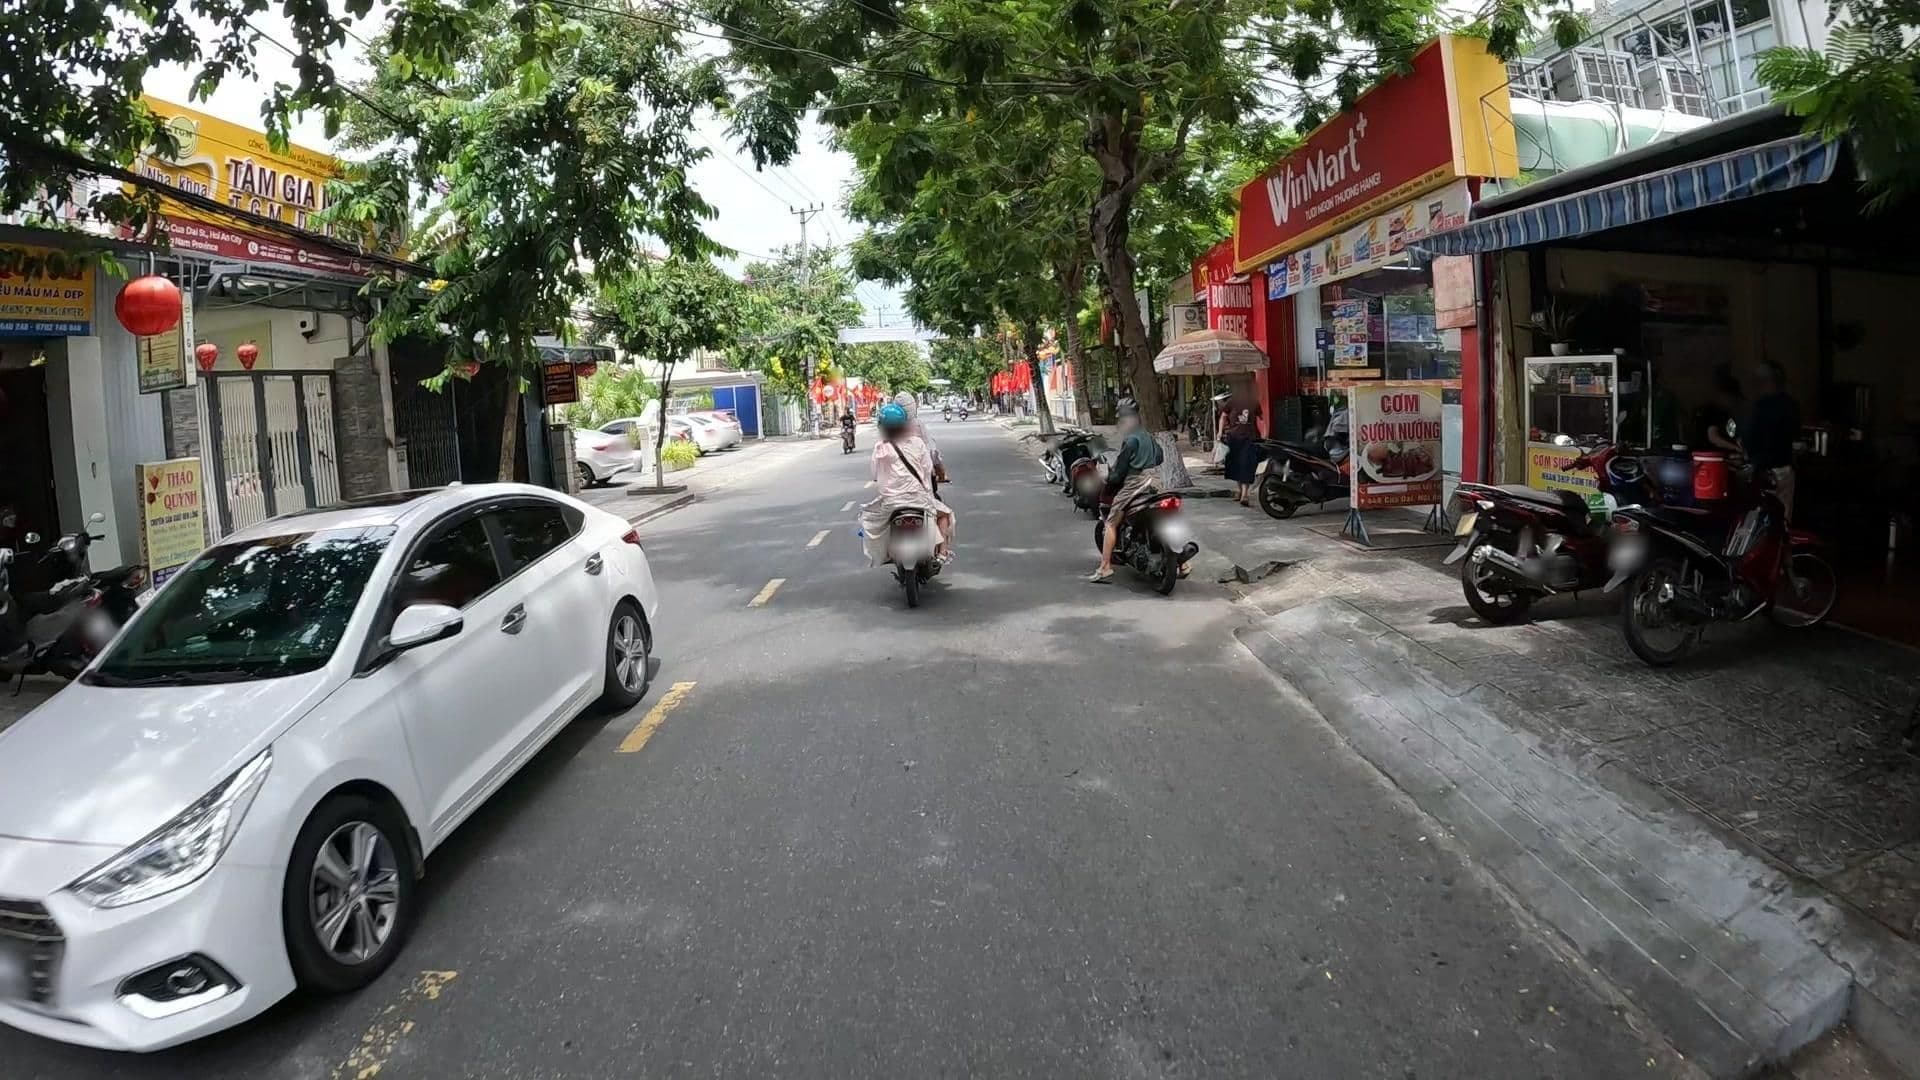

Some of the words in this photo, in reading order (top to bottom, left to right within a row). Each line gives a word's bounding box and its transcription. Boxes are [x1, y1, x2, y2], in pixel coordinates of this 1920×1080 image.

[230, 157, 277, 199] TÂM
[282, 173, 316, 209] GIA
[192, 240, 219, 252] Province
[221, 233, 230, 242] An
[1211, 284, 1251, 309] BOOKING
[1217, 314, 1248, 337] OFFICE
[1381, 393, 1419, 413] CƠM
[1398, 419, 1440, 441] NƯỚNG
[166, 466, 194, 488] THẢO
